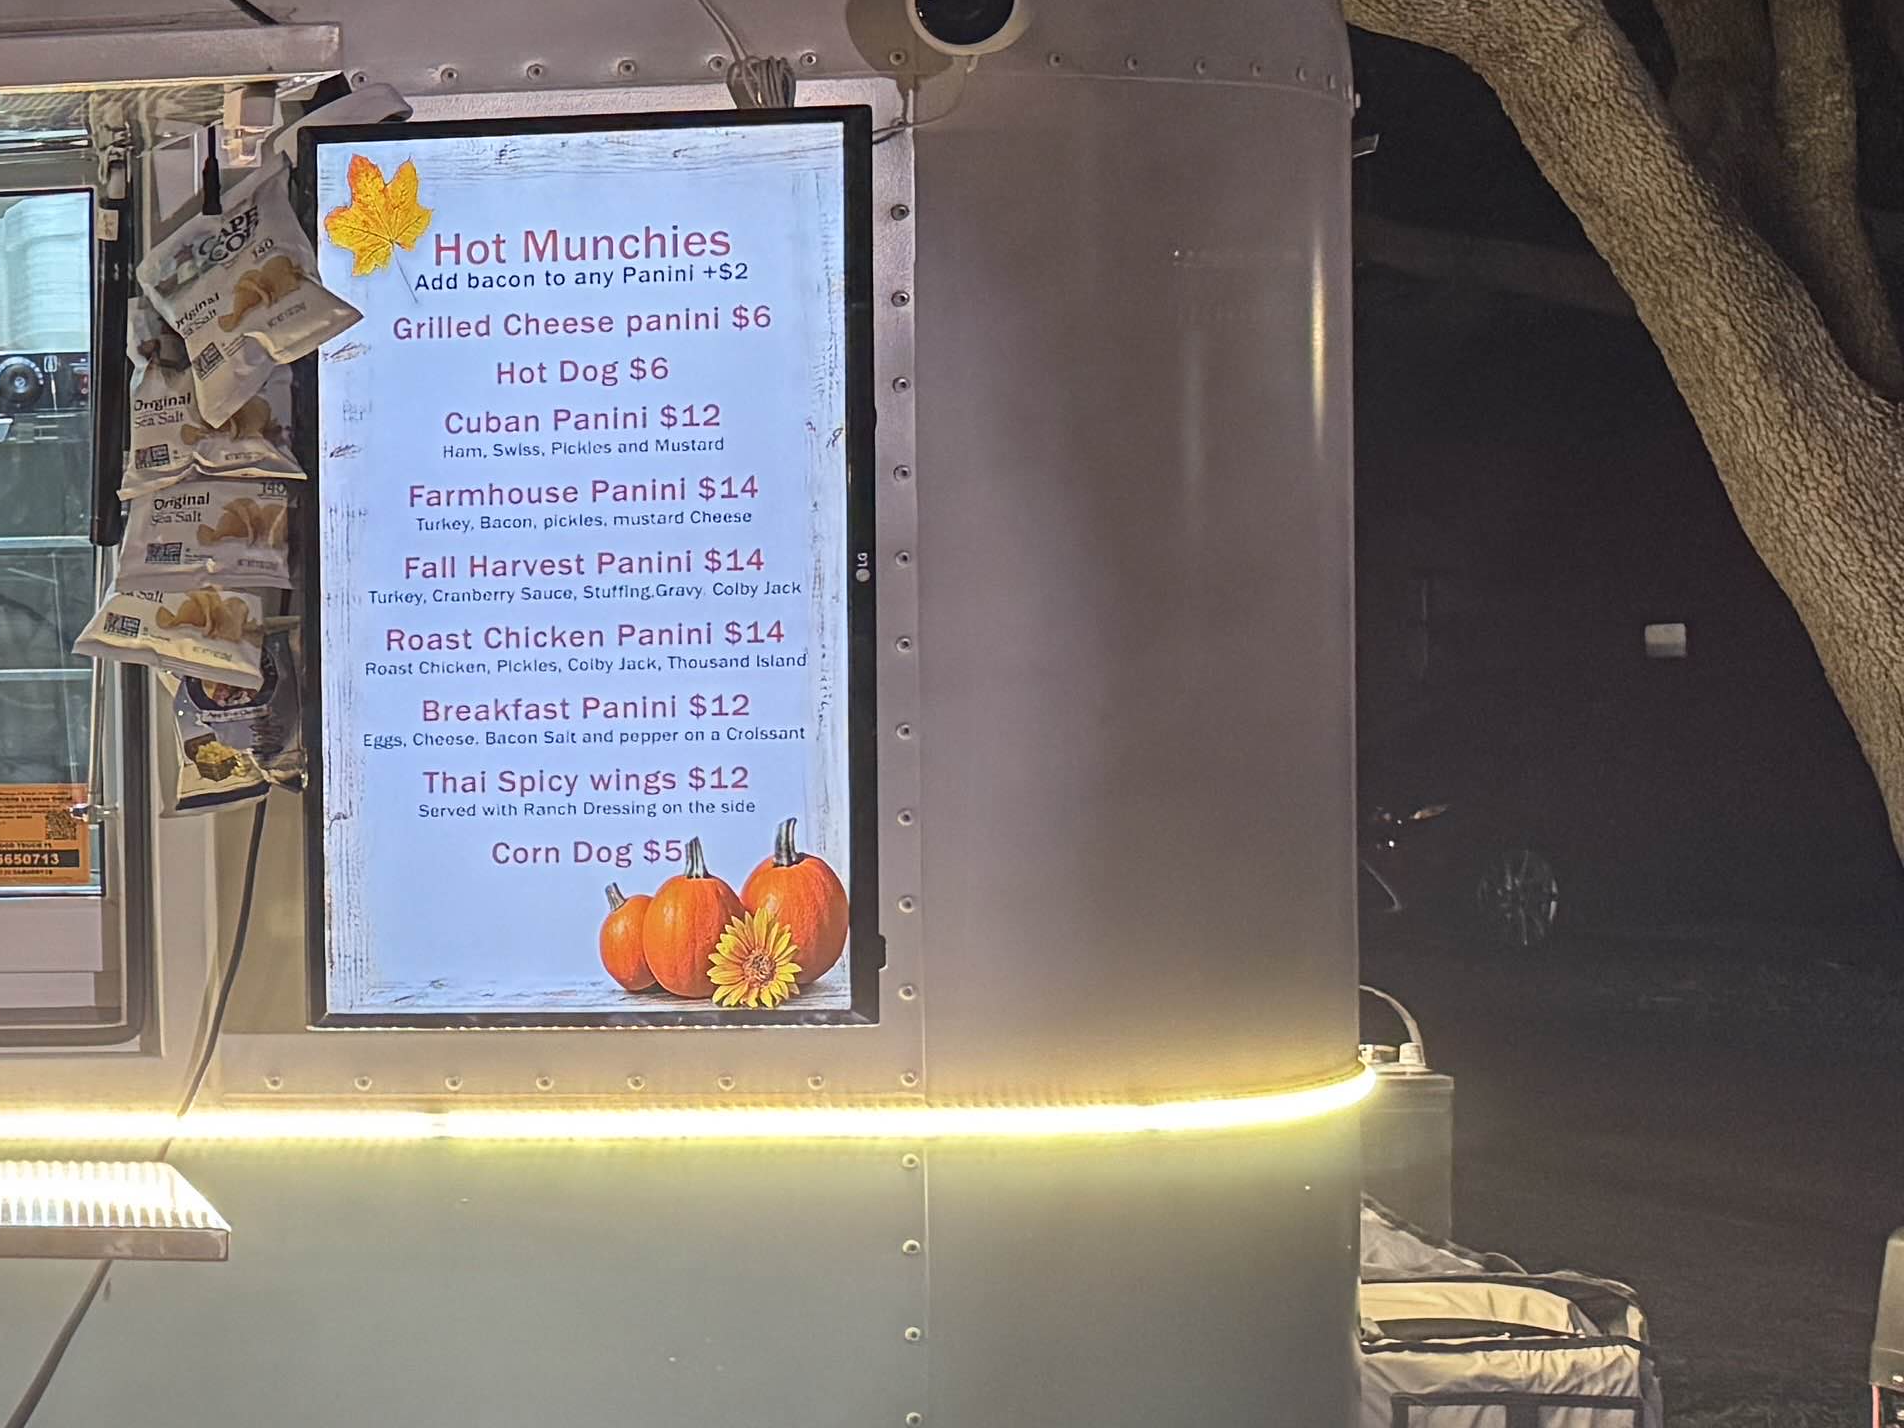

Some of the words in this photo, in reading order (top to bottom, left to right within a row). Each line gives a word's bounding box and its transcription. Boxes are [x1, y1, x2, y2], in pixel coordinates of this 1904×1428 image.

[435, 233, 506, 266] Hot
[525, 225, 730, 262] Munchies
[415, 273, 457, 290] Add
[468, 273, 534, 288] bacon
[546, 271, 565, 286] to
[575, 271, 613, 288] any
[624, 265, 693, 283] Panini
[704, 263, 747, 280] +$2
[394, 315, 490, 340] Grilled
[504, 313, 613, 335] Cheese
[628, 307, 718, 337] panini
[733, 305, 770, 330] $6
[498, 362, 546, 384] Hot
[560, 361, 618, 386] Dog
[630, 357, 668, 380] $6
[135, 392, 191, 411] Original
[446, 412, 539, 434] Cuban
[554, 406, 646, 431] Panini
[661, 404, 720, 429] $12
[444, 446, 487, 458] Ham,
[552, 441, 611, 454] Pickles
[618, 440, 648, 453] and
[656, 437, 723, 451] Mustard
[154, 492, 209, 510] Original
[410, 484, 578, 507] Farmhouse
[592, 478, 685, 502] Panini
[699, 475, 758, 501] $14
[614, 512, 684, 525] mustard
[691, 511, 751, 523] Cheese
[406, 556, 455, 579] Fall
[471, 554, 584, 577] Harvest
[598, 550, 691, 574] Panini
[705, 548, 764, 573] $14
[857, 553, 868, 567] LG
[368, 591, 426, 605] Turkey,
[433, 589, 514, 603] Cranberry
[522, 587, 576, 600] Sauce,
[713, 583, 758, 597] Colby
[764, 582, 801, 594] Jack
[387, 629, 472, 651] Roast
[485, 626, 603, 649] Chicken
[619, 622, 711, 646] Panini
[725, 620, 784, 644] $14
[366, 663, 412, 675] Roast
[419, 661, 490, 674] Chicken,
[498, 660, 561, 673] Pickles,
[568, 658, 613, 673] Colby
[619, 658, 661, 671] Jack,
[668, 655, 749, 668] Thousand
[757, 654, 806, 667] Island
[423, 698, 569, 721] Breakfast
[583, 695, 675, 719] Panini
[690, 694, 749, 718] $12
[364, 734, 406, 749] Eggs,
[486, 732, 537, 745] Bacon
[544, 731, 576, 743] Salt
[583, 730, 613, 743] and
[620, 732, 678, 744] pepper
[685, 731, 704, 740] on
[712, 731, 720, 740] a
[727, 727, 804, 740] Croissant
[423, 771, 485, 793] Thai
[499, 770, 578, 797] Spicy
[590, 769, 676, 795] wings
[689, 767, 748, 791] $12
[419, 804, 475, 817] Served
[483, 804, 517, 816] with
[525, 803, 576, 815] Ranch
[584, 802, 656, 817] Dressing
[663, 804, 682, 813] on
[689, 801, 715, 813] the
[722, 800, 755, 813] side
[493, 842, 559, 864] Corn
[574, 841, 632, 868] Dog
[644, 840, 681, 863] $5
